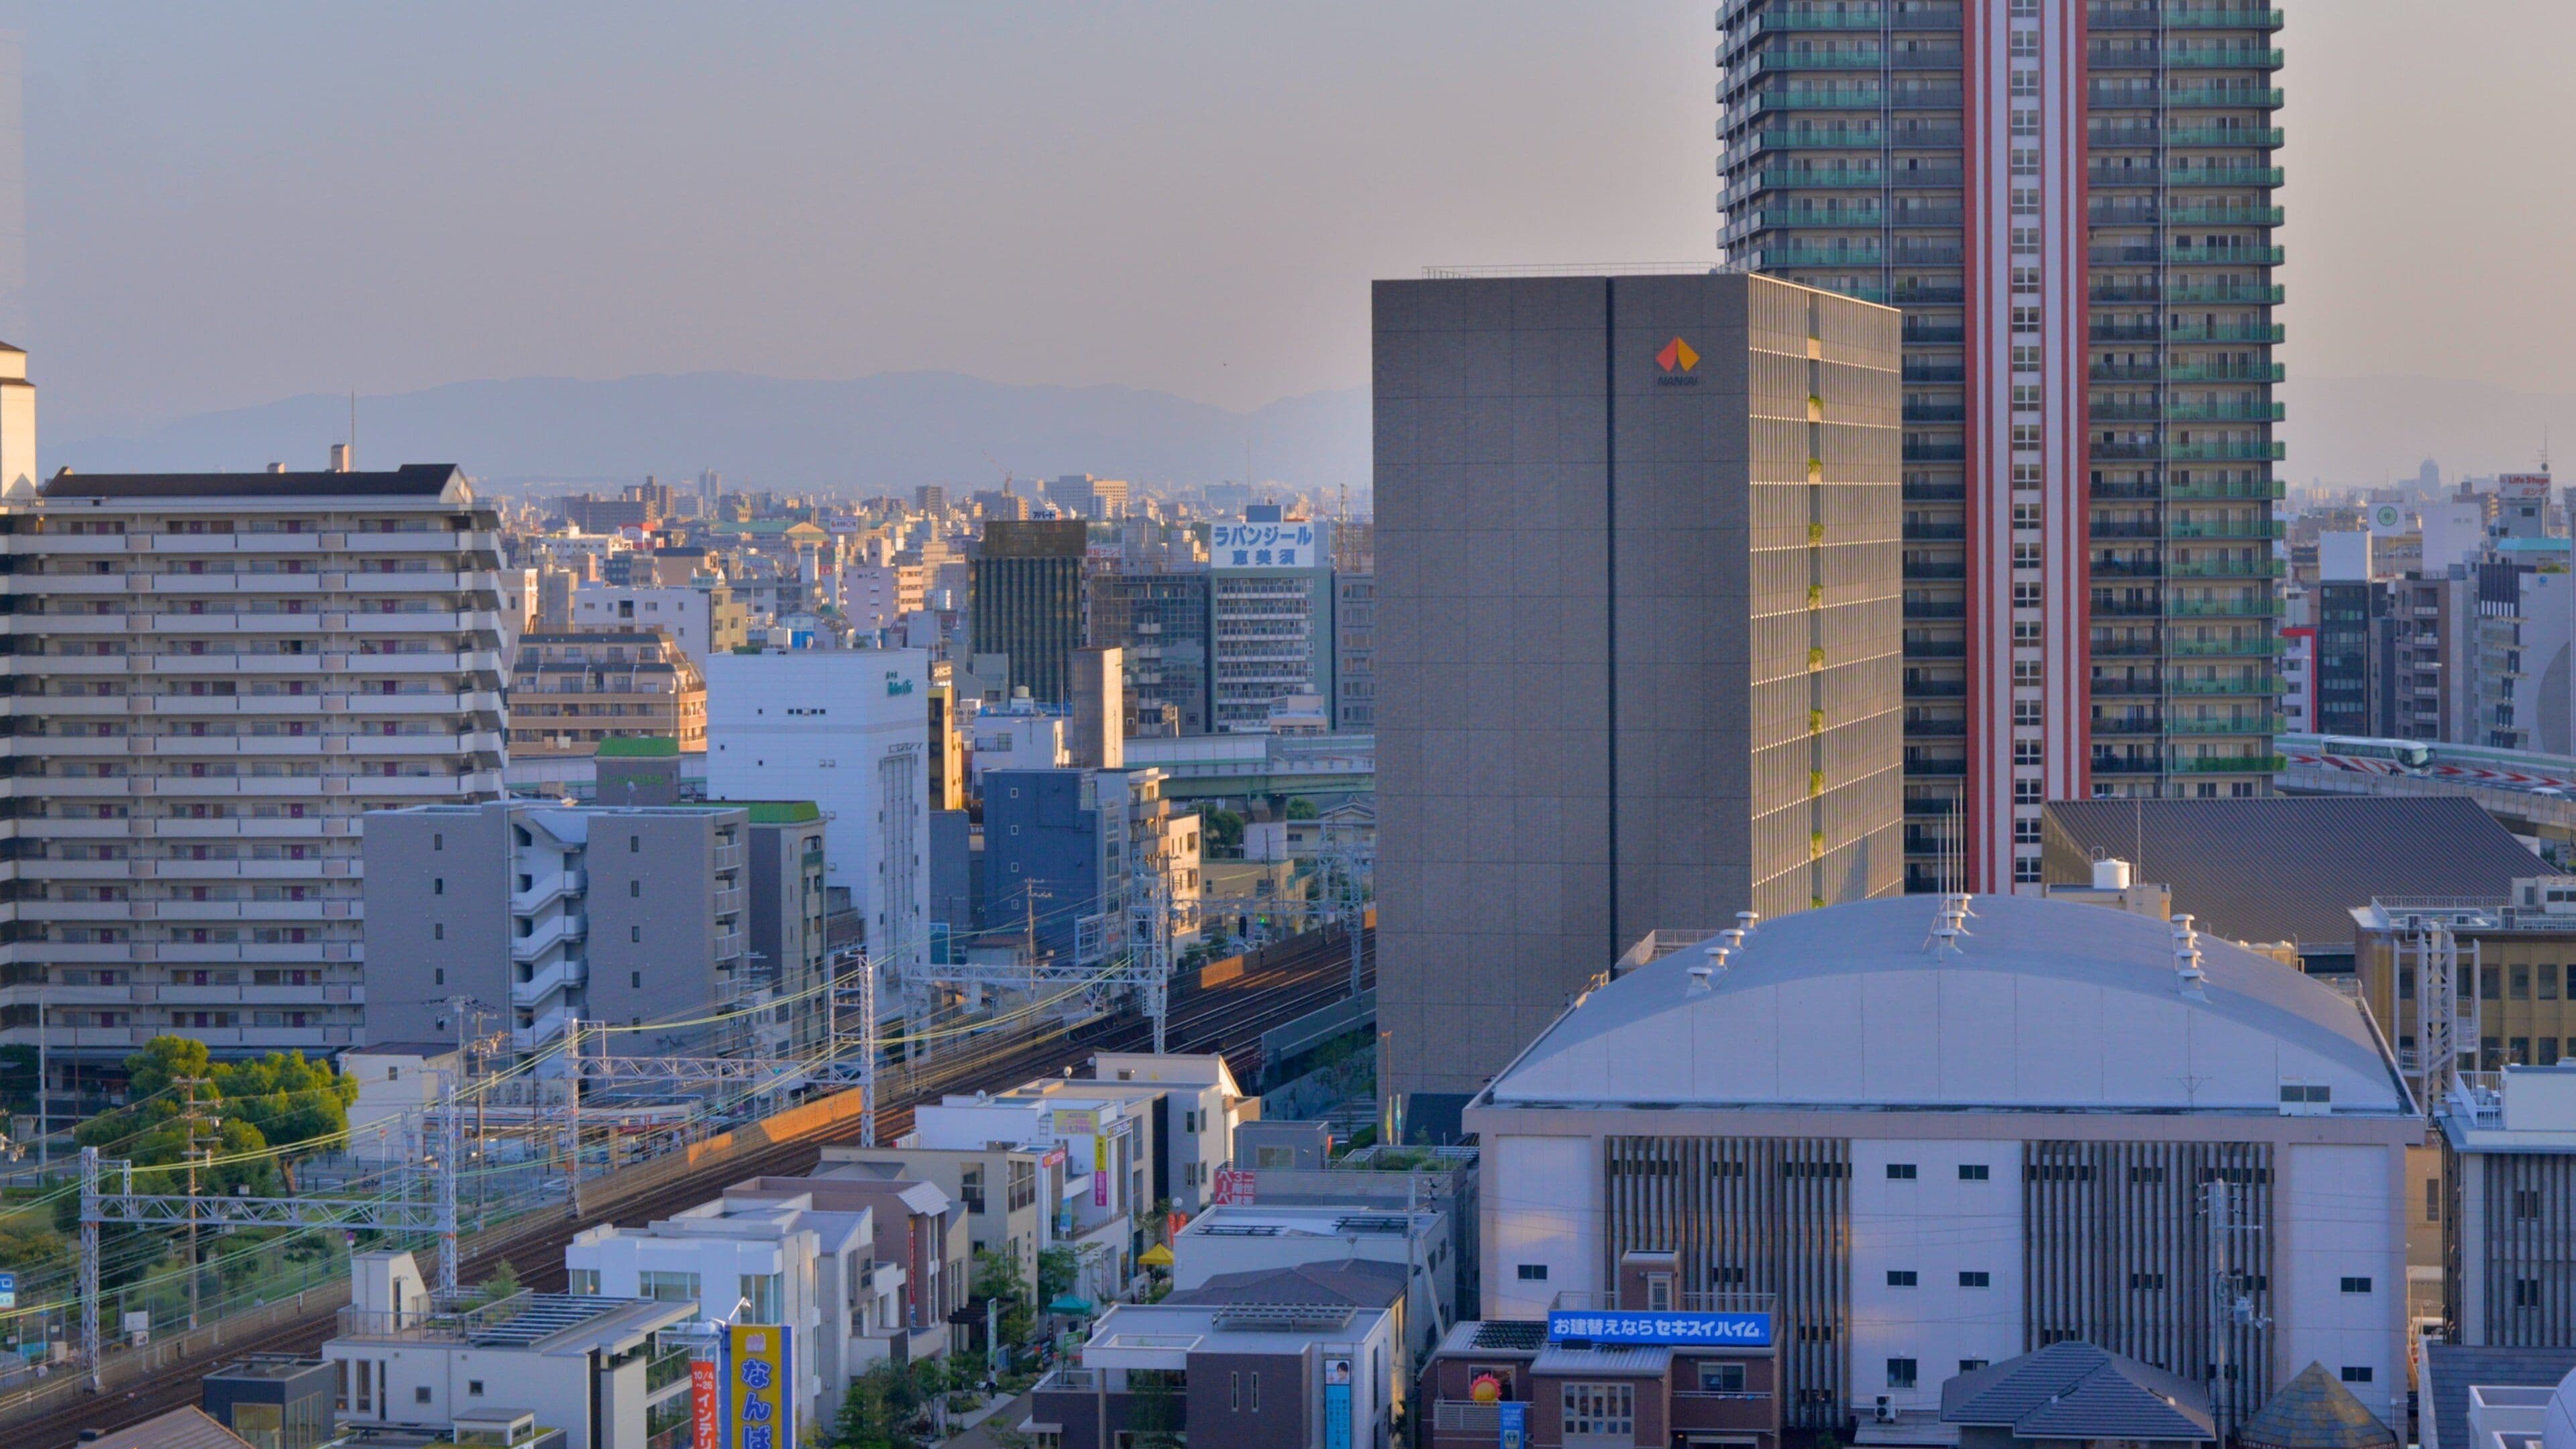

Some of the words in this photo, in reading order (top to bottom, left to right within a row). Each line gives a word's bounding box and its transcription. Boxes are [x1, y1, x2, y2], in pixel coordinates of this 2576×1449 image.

[1214, 525, 1313, 547] ラパンジール
[1232, 549, 1295, 565] 恵美須
[742, 1358, 771, 1449] なんば
